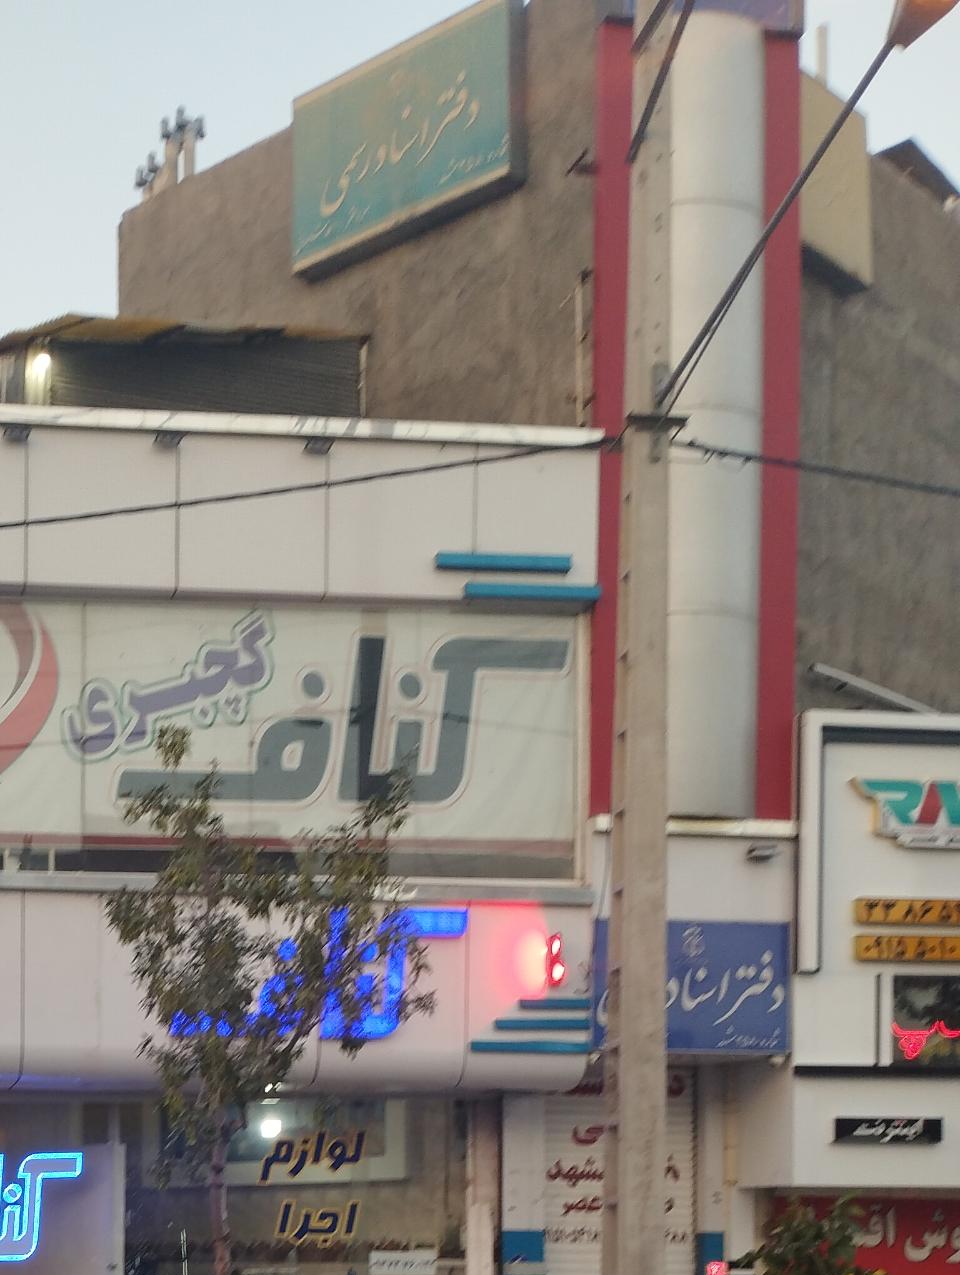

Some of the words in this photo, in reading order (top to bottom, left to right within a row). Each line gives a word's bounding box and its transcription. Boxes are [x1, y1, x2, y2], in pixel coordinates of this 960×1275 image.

[64, 609, 272, 760] گچبری
[115, 635, 570, 803] کناف
[712, 949, 786, 1028] دفتر
[258, 1129, 366, 1185] لوازم
[274, 1199, 362, 1248] اجرا
